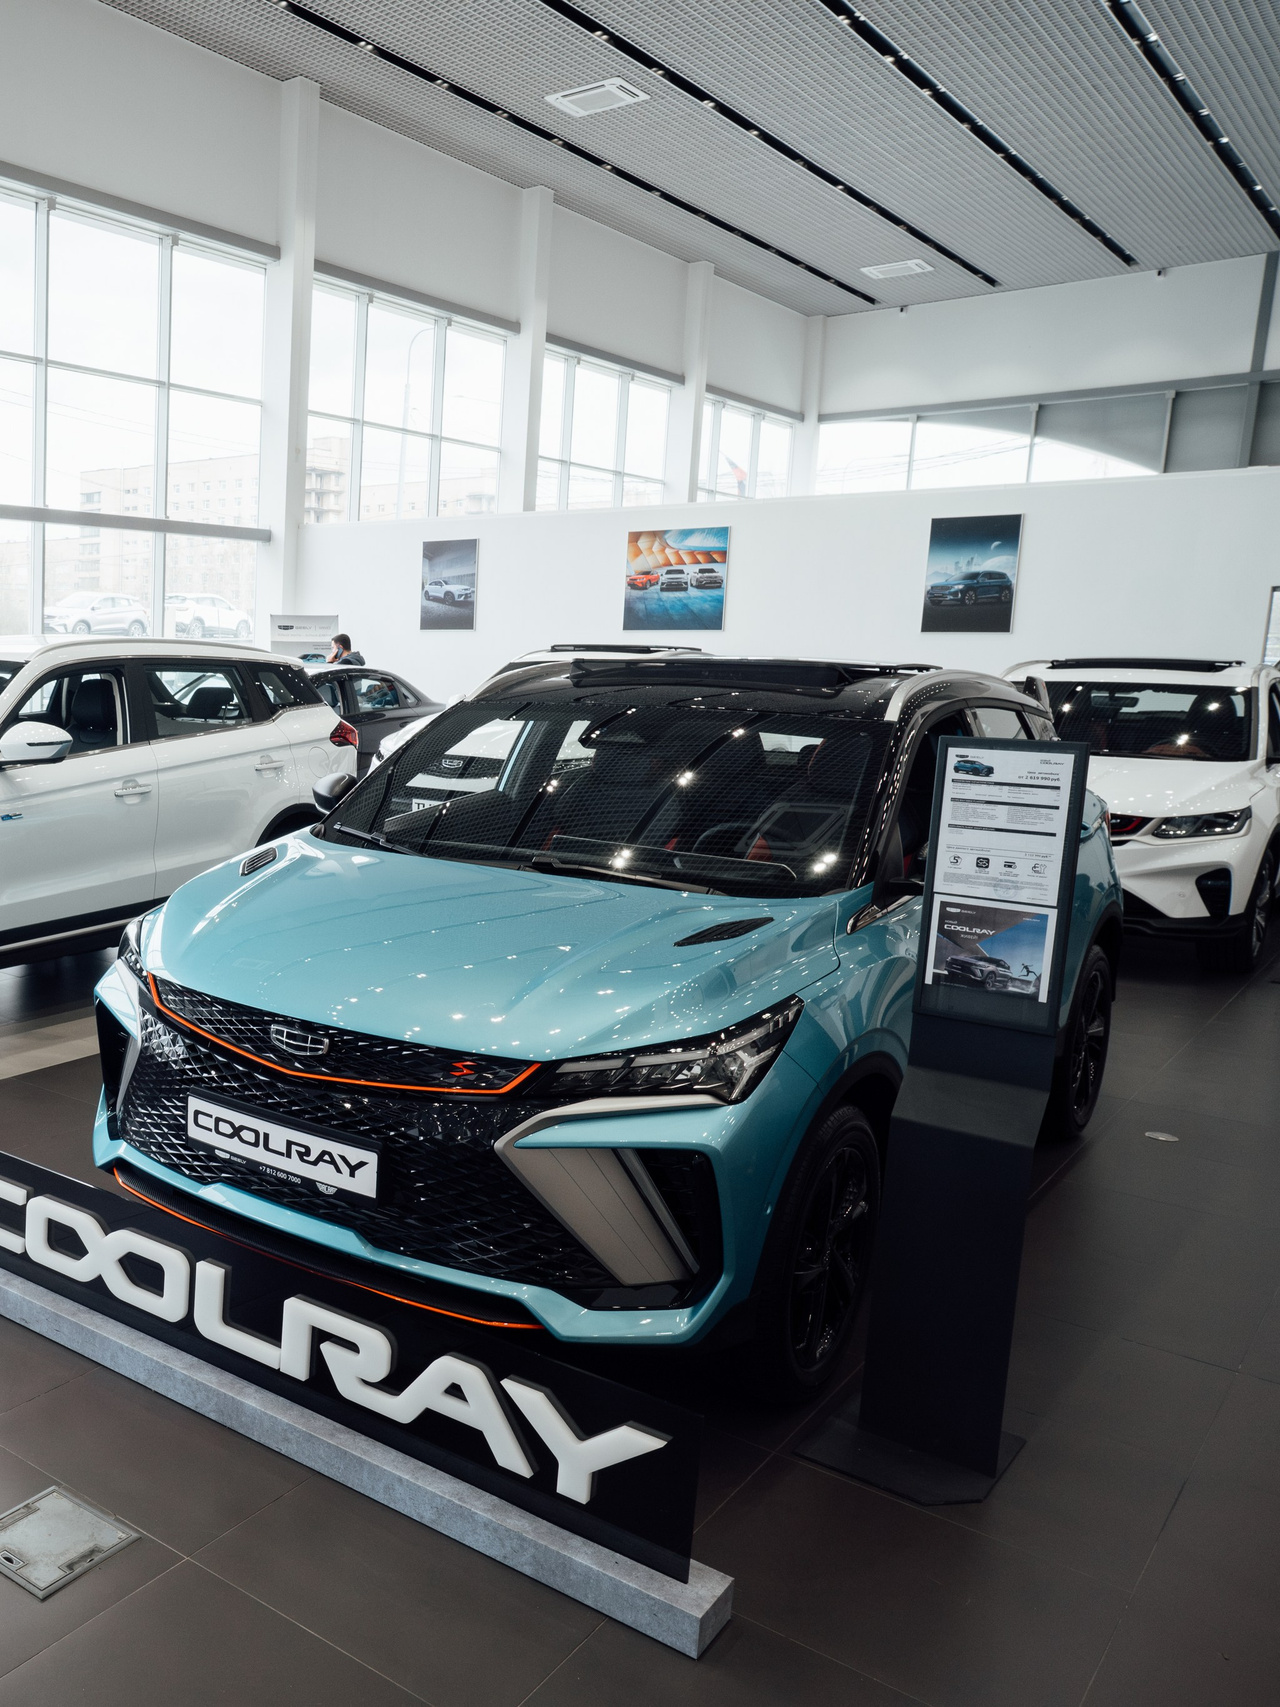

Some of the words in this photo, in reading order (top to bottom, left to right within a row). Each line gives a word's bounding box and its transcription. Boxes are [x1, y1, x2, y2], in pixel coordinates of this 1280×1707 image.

[943, 923, 996, 936] COOLRAY
[193, 1109, 370, 1179] COOLRAY
[266, 1167, 277, 1176] 812
[277, 1170, 288, 1180] 600
[288, 1174, 302, 1184] 7000
